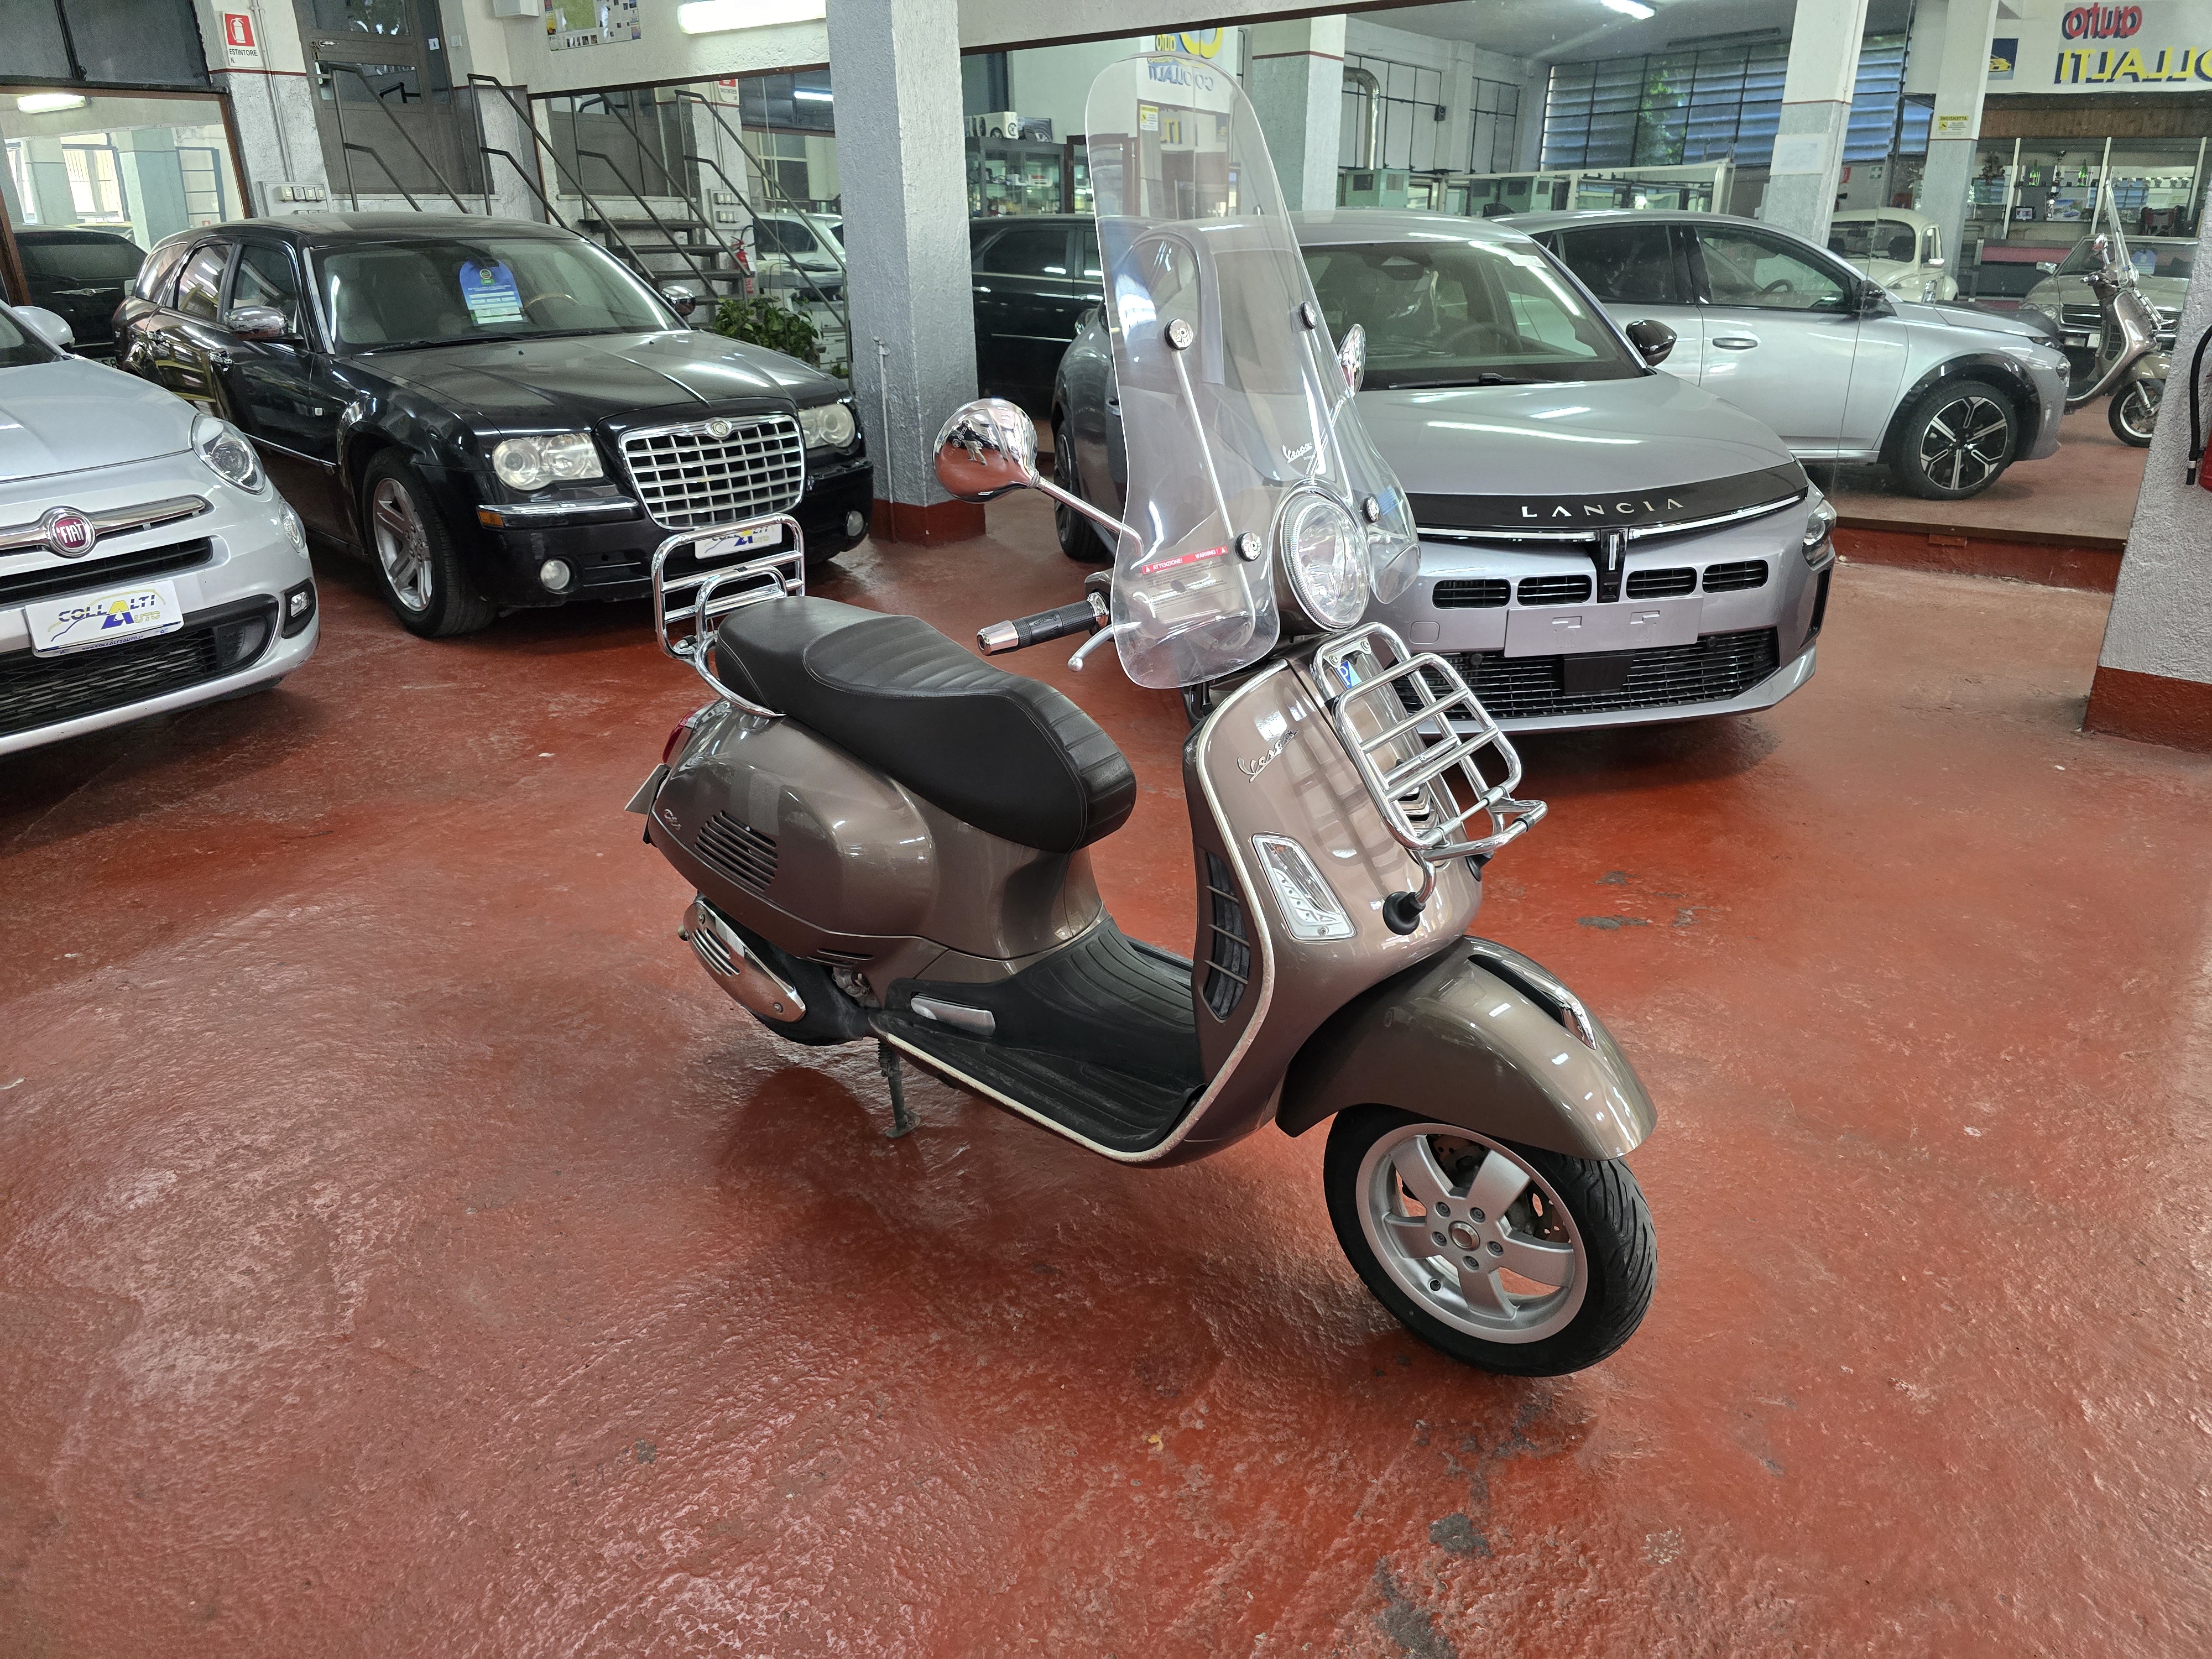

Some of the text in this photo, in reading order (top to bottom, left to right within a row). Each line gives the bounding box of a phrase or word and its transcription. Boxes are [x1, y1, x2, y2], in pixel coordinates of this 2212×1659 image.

[1282, 442, 1313, 464] Vespa
[1521, 498, 1684, 518] LANCIA
[60, 523, 84, 544] FIAT
[1152, 557, 1183, 570] ATTENZIONE!
[59, 594, 155, 630] COLLALTI
[1237, 729, 1300, 783] Vespa
